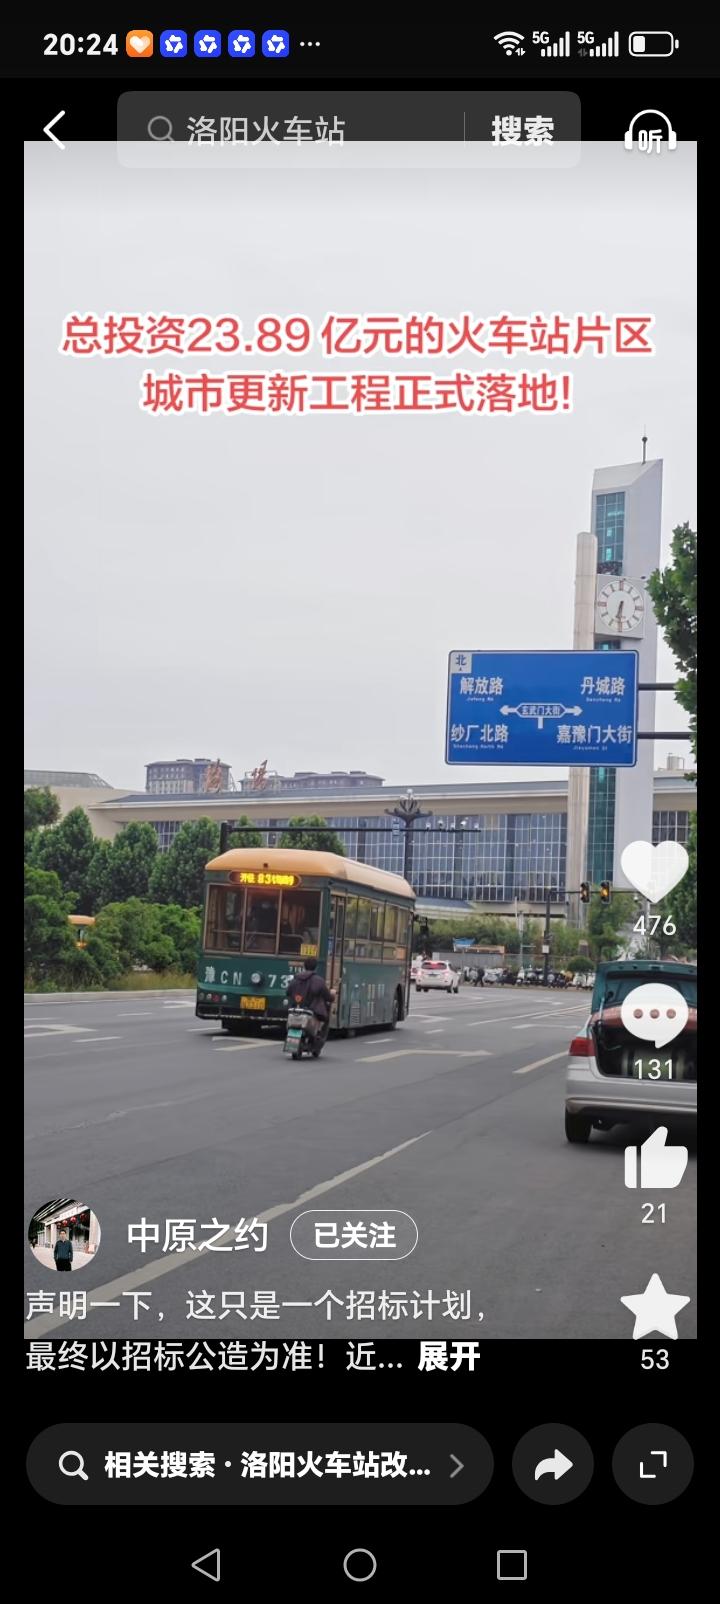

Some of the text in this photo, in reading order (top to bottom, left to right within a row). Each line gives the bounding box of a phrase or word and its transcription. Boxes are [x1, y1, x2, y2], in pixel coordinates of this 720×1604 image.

[455, 654, 467, 667] 北
[459, 676, 504, 696] 解放路
[580, 676, 626, 696] 丹城路
[521, 705, 561, 716] 玄武门大街
[450, 723, 509, 743] 纱厂北路
[556, 724, 633, 745] 嘉豫门大街
